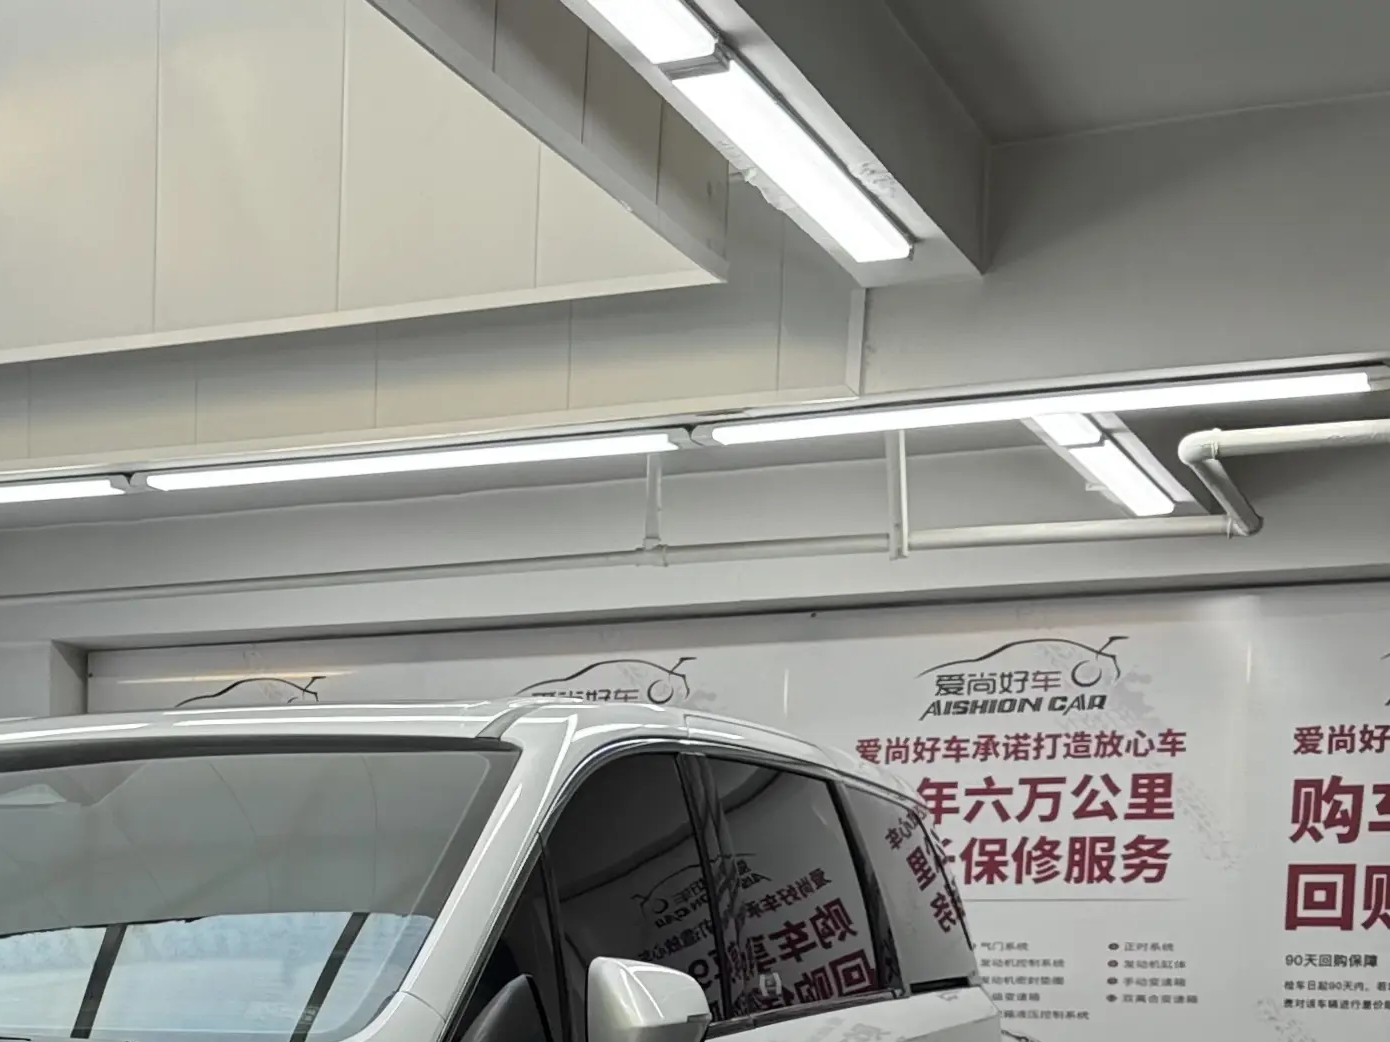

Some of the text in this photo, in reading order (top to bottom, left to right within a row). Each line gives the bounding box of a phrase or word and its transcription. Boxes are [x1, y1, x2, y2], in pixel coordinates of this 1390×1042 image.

[935, 671, 1062, 696] 爱尚好车
[918, 694, 1108, 721] AISHION CAR
[855, 728, 1187, 765] 爱尚好车承诺打造放心车
[940, 834, 1172, 885] 保修服务
[1285, 953, 1378, 968] 90天回购保障
